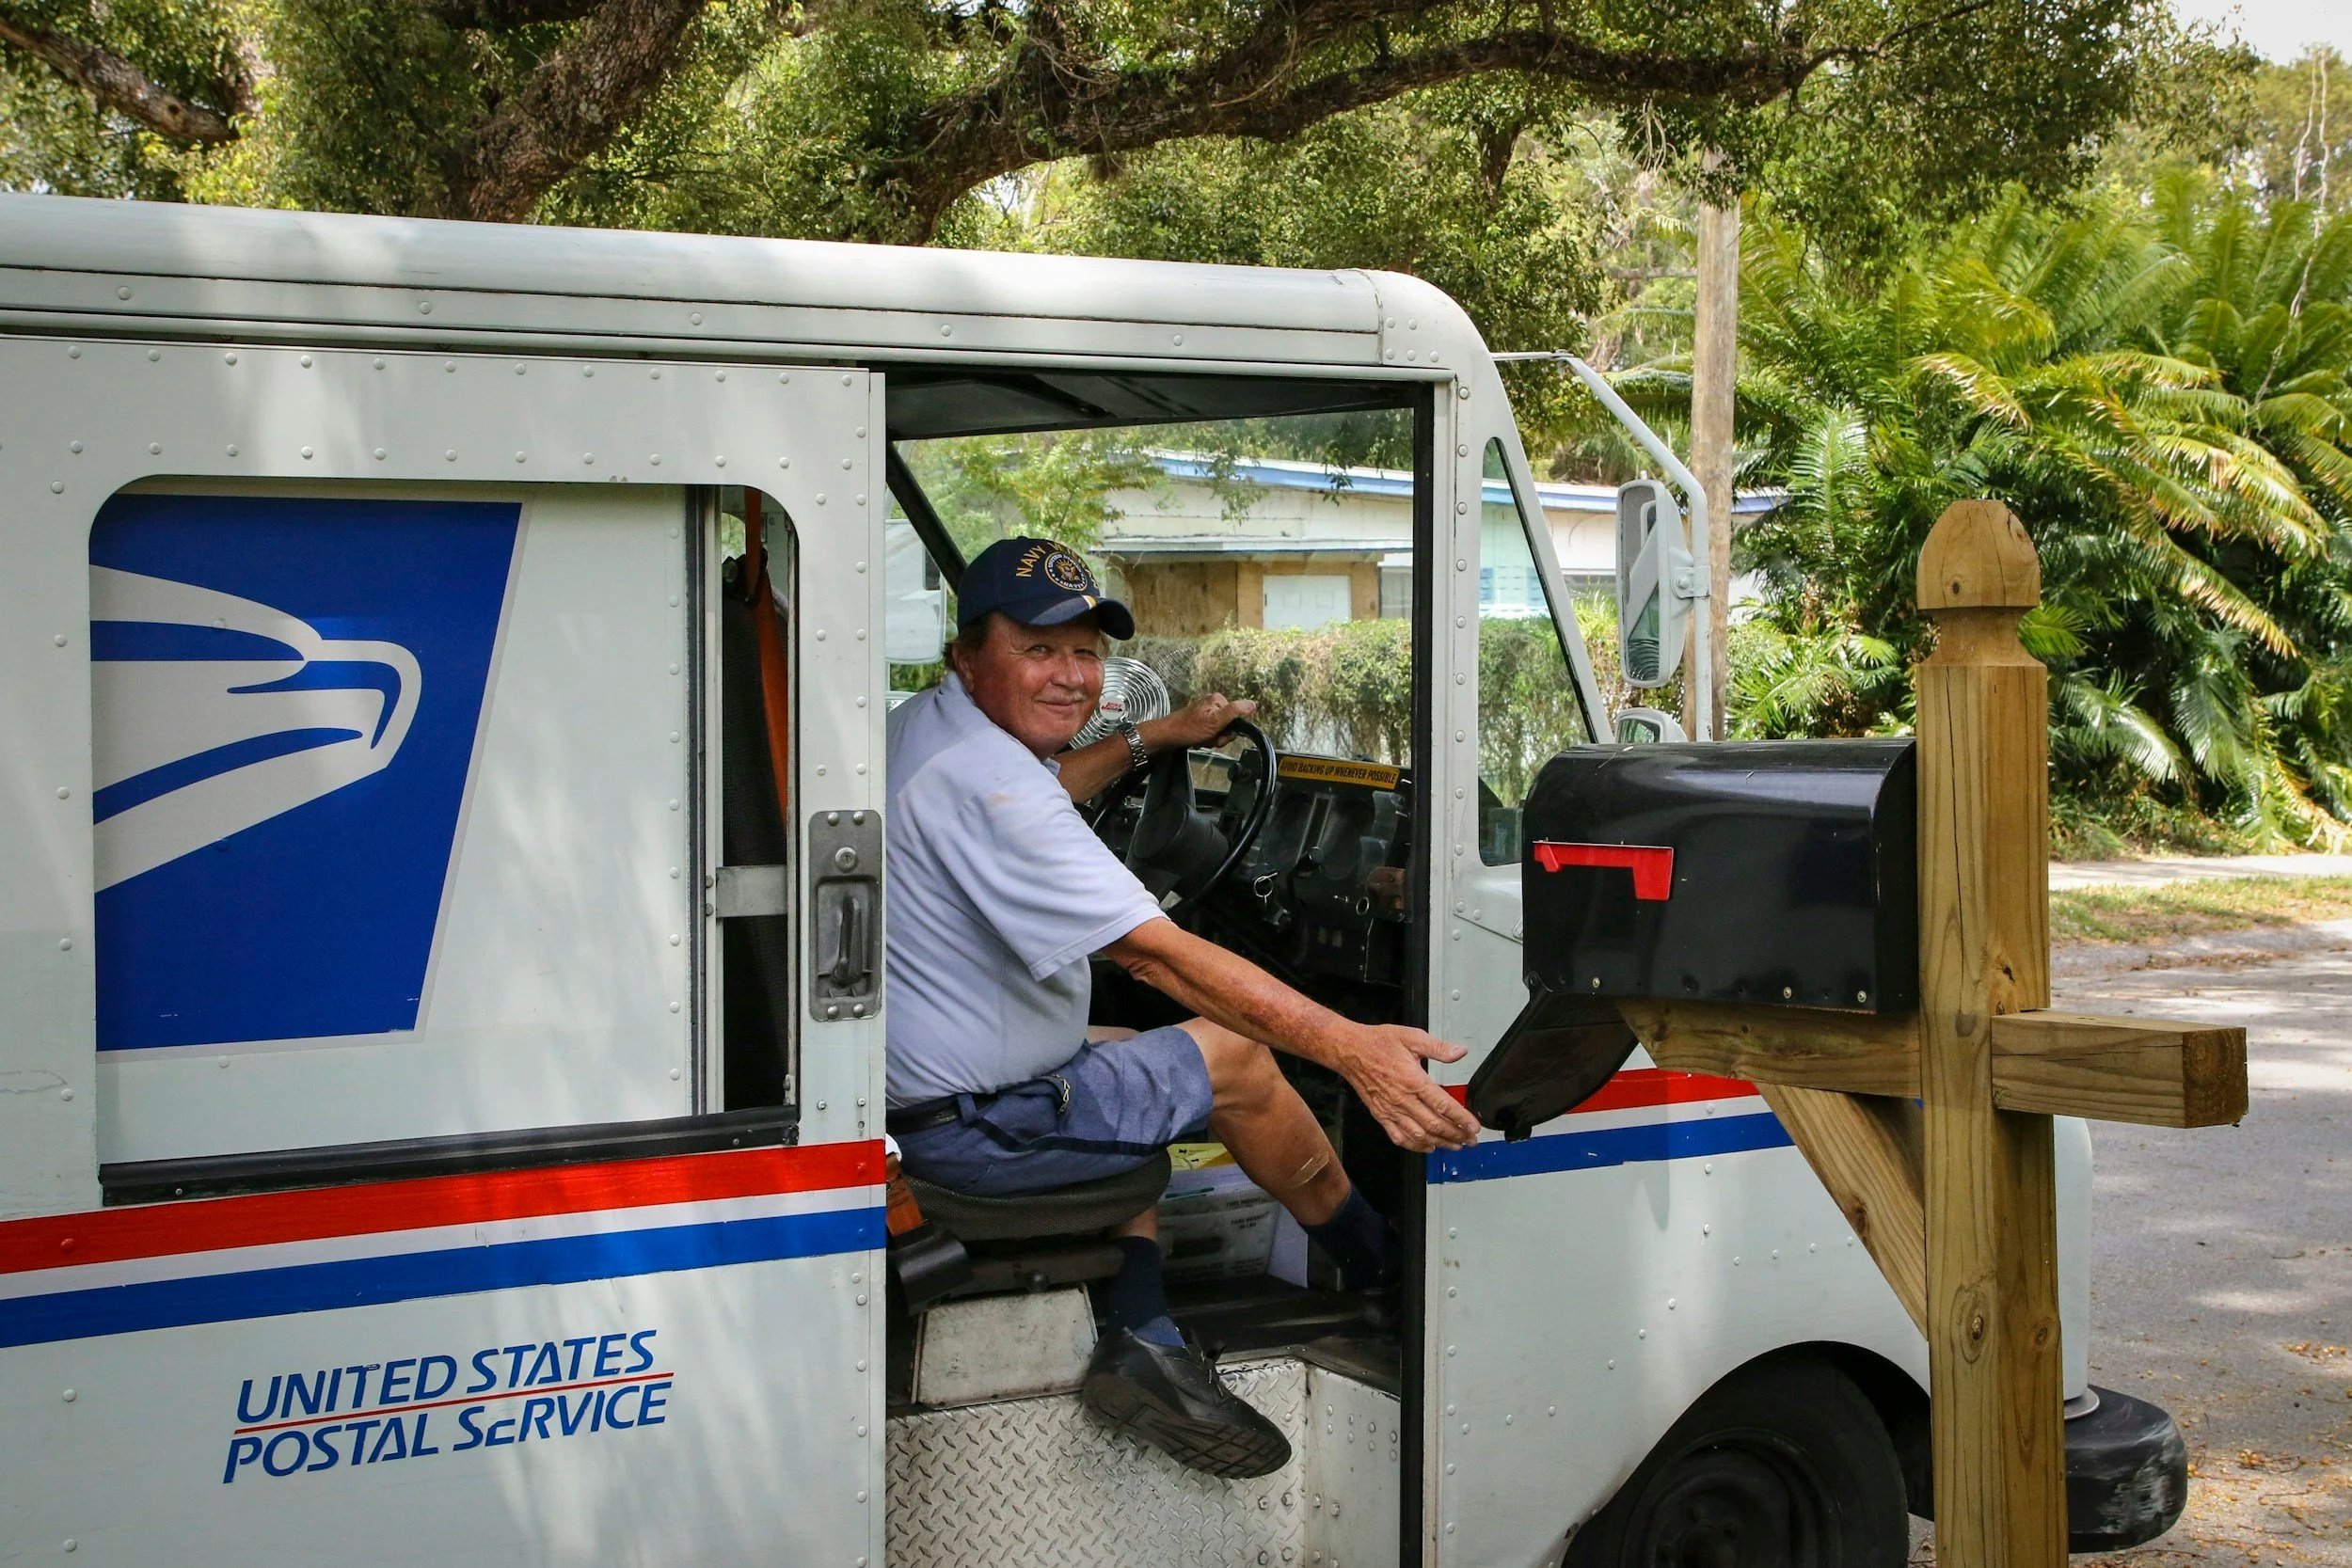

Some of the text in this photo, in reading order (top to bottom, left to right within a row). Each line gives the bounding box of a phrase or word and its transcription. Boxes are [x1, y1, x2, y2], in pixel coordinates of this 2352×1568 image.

[1016, 545, 1046, 578] NAVY
[1279, 761, 1397, 784] AVOID BACKING UP WHENEVER POSSIBLE
[236, 1329, 658, 1423] UNITED STATES
[223, 1381, 673, 1484] POSTAL SERVICE
